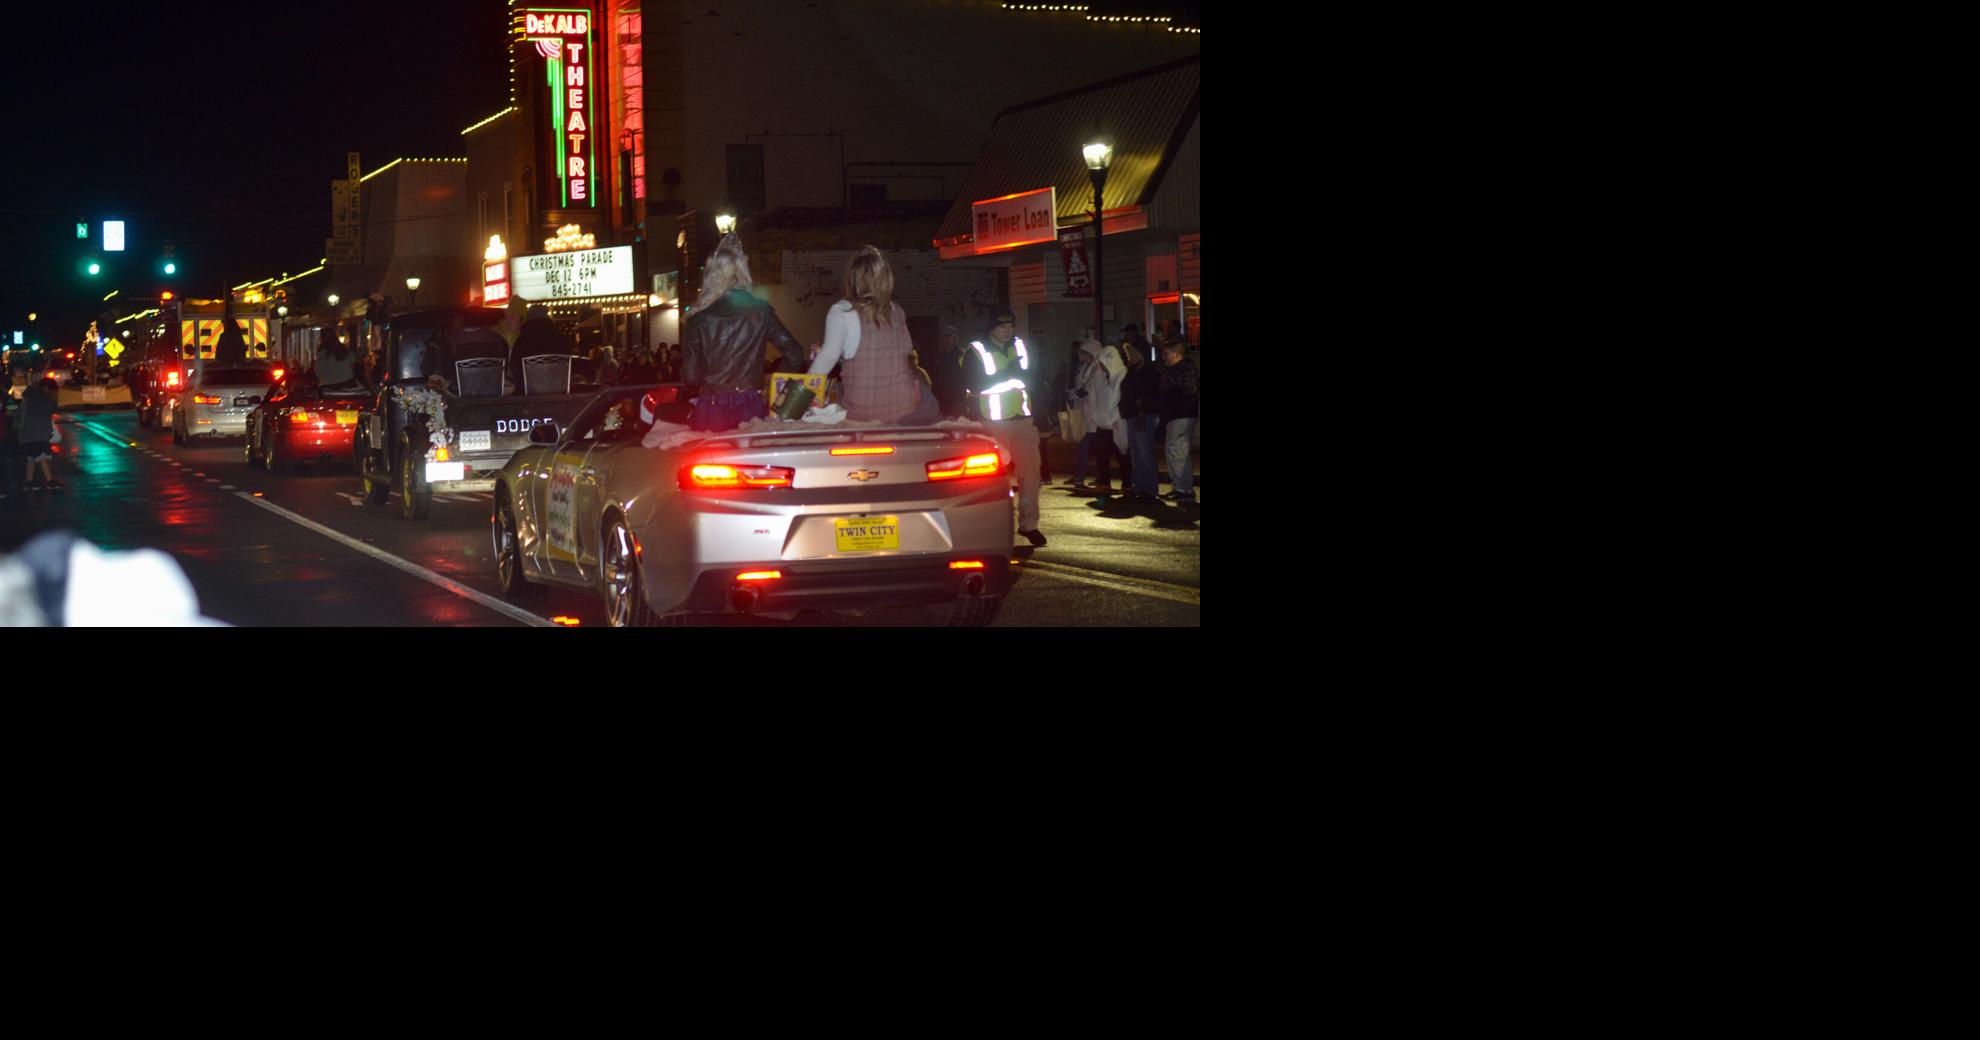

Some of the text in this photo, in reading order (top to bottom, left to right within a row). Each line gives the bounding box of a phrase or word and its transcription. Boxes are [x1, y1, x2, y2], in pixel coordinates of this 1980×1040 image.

[567, 43, 586, 200] THEATRE
[991, 206, 1050, 235] Tower Loan
[529, 250, 613, 270] CHRISTMAS PARADE
[545, 267, 597, 283] DEC 12 6PM
[552, 282, 592, 297] 845-2741
[839, 525, 896, 537] TWIN CITY
